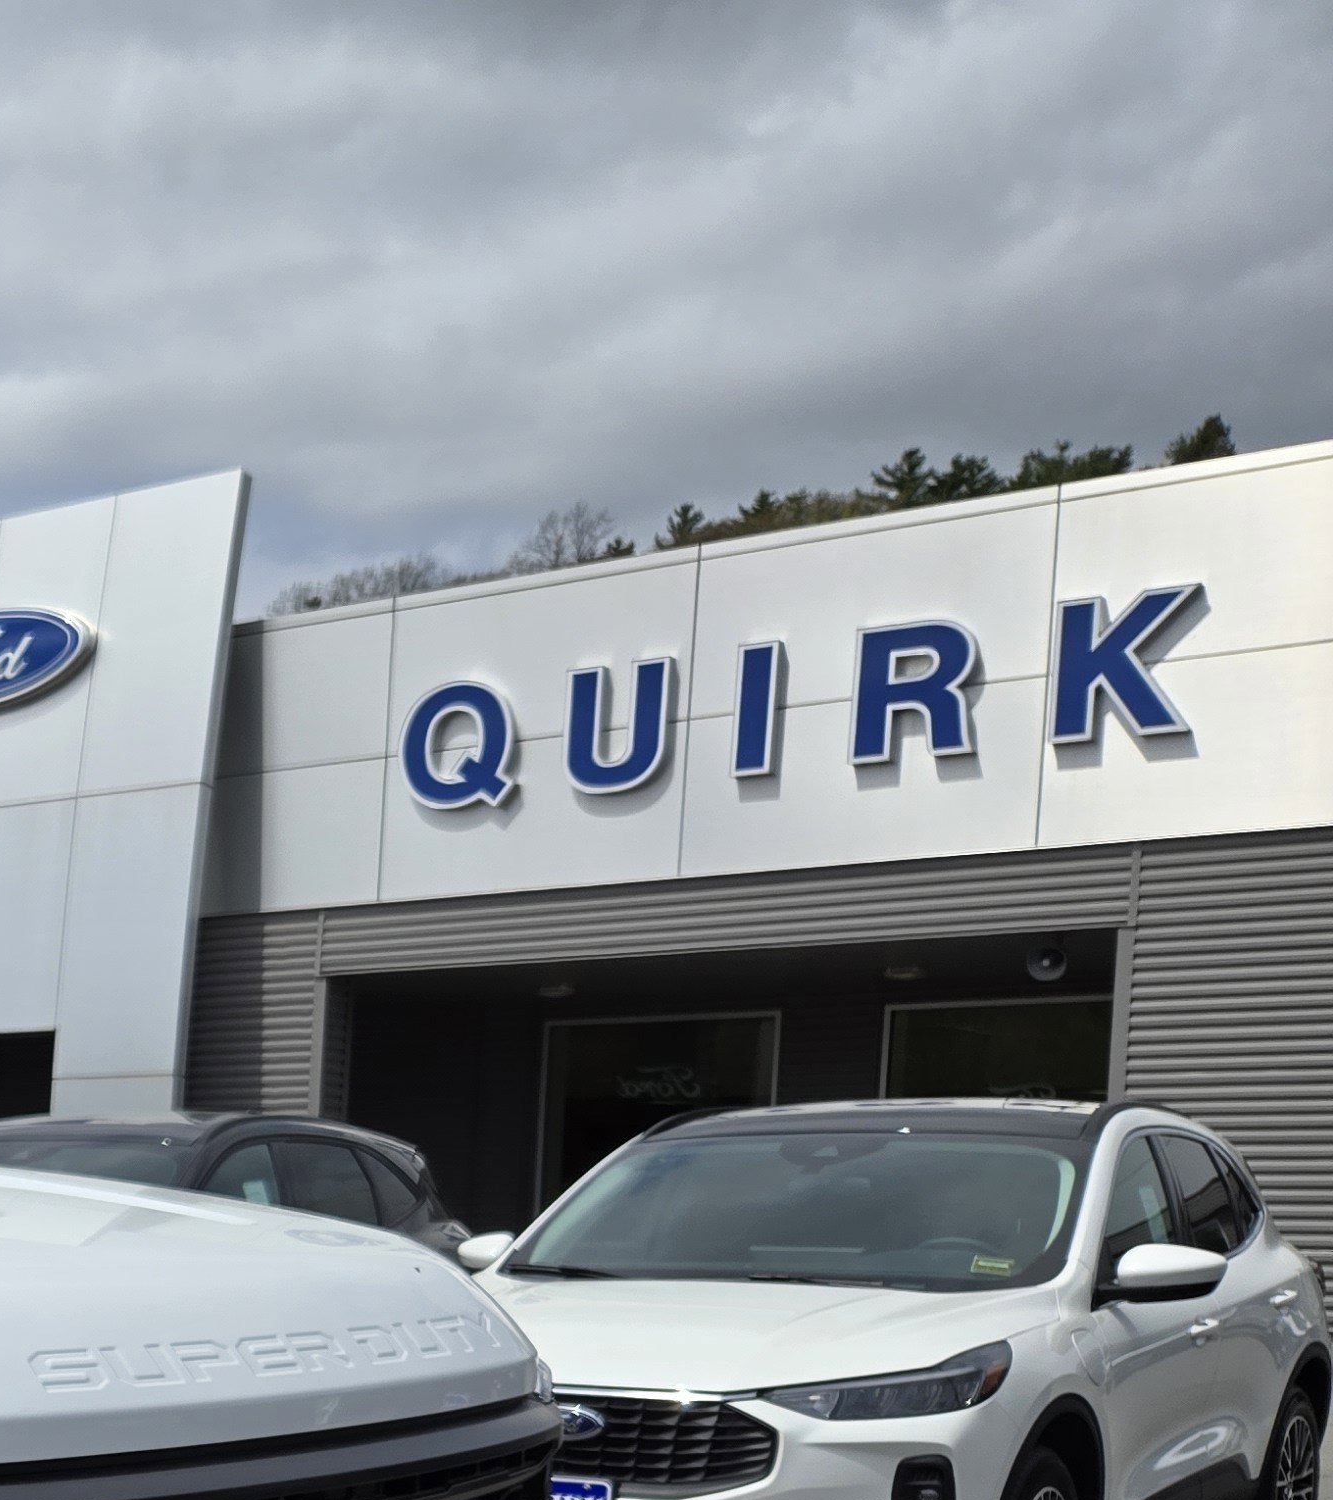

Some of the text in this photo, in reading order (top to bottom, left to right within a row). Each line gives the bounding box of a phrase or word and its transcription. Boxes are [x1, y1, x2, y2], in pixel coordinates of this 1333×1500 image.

[398, 583, 1205, 809] QUIRK
[28, 1311, 501, 1394] SUPER DUTY
